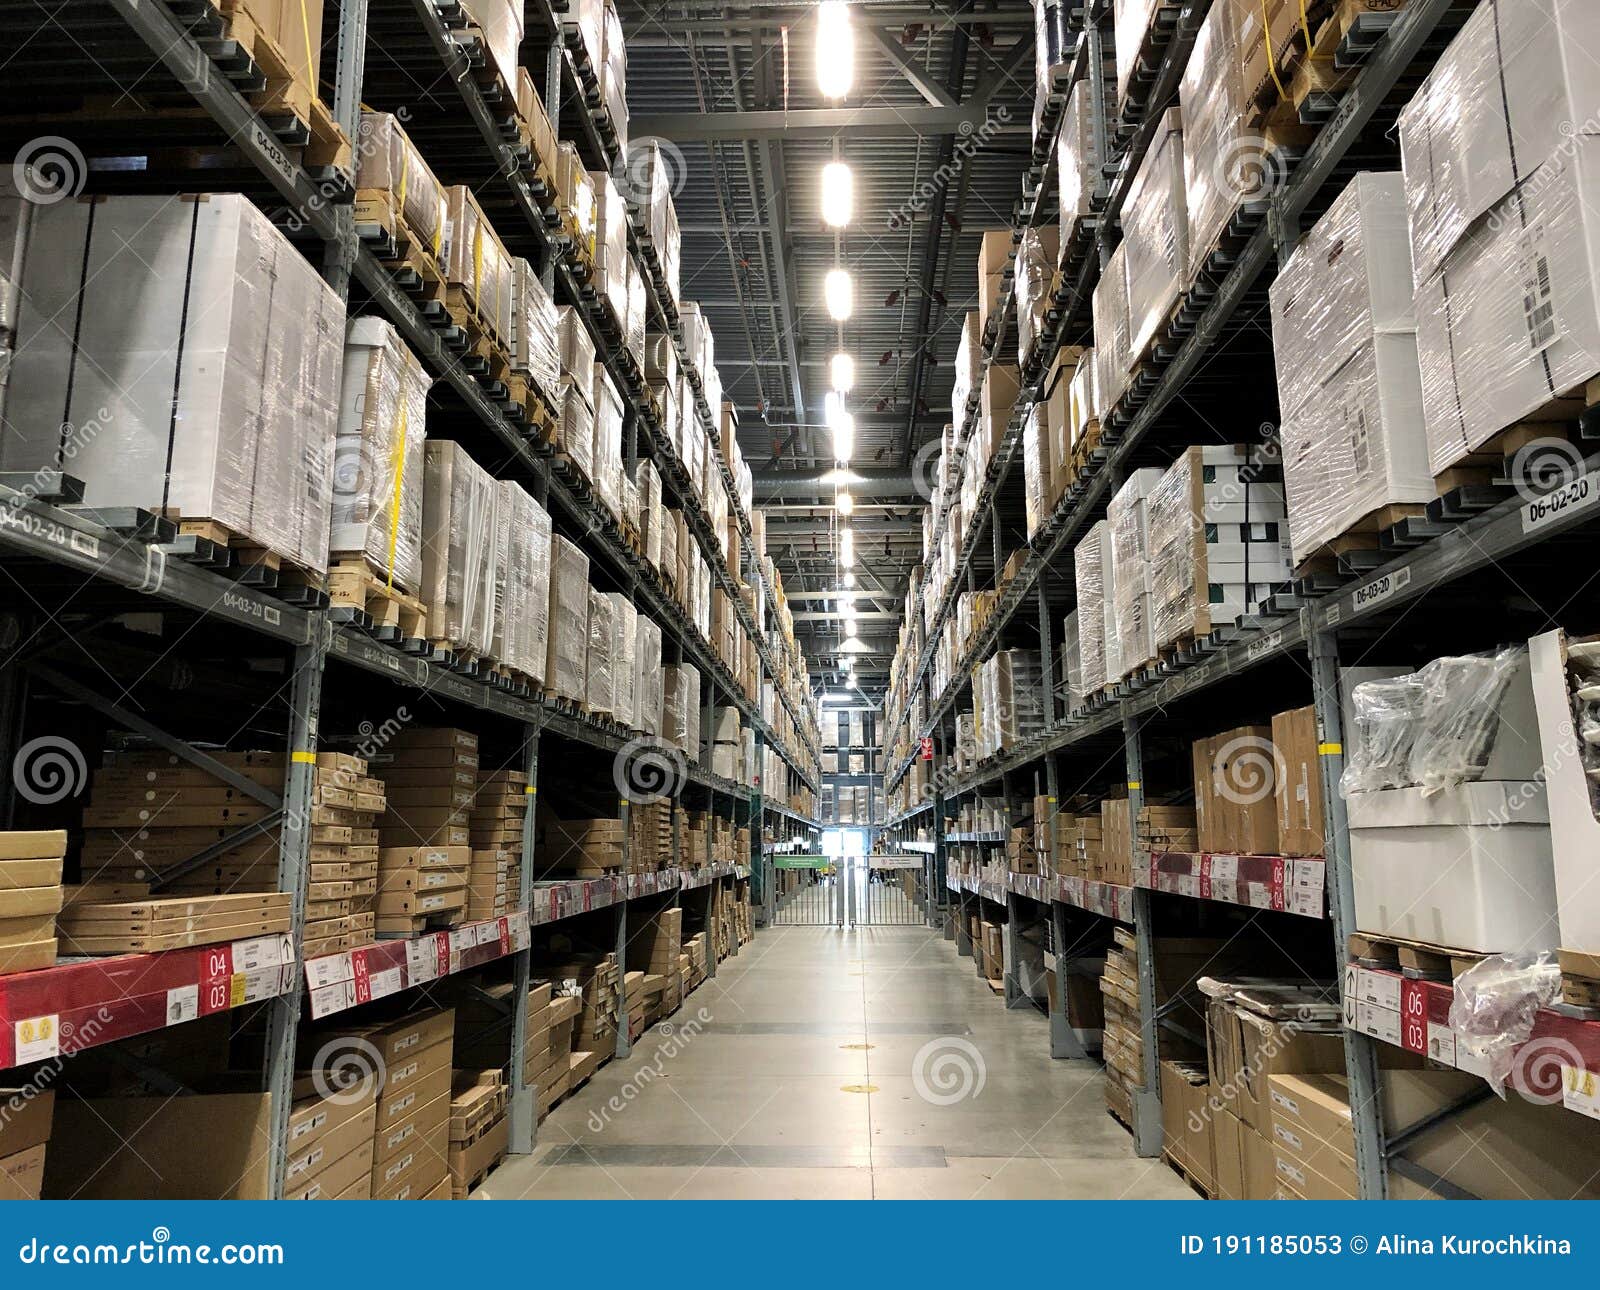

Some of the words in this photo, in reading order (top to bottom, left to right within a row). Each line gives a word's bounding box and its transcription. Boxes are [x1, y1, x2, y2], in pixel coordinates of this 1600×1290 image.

[1530, 479, 1589, 522] 06-02-20
[0, 506, 65, 544] 04-02-20
[1357, 577, 1390, 604] 06-03-20
[224, 592, 262, 617] 04-03-20
[210, 953, 227, 977] 04
[355, 959, 367, 976] 04
[210, 985, 226, 1009] 03
[359, 983, 369, 1001] 04
[1408, 991, 1423, 1016] 06
[1409, 1025, 1423, 1050] 03
